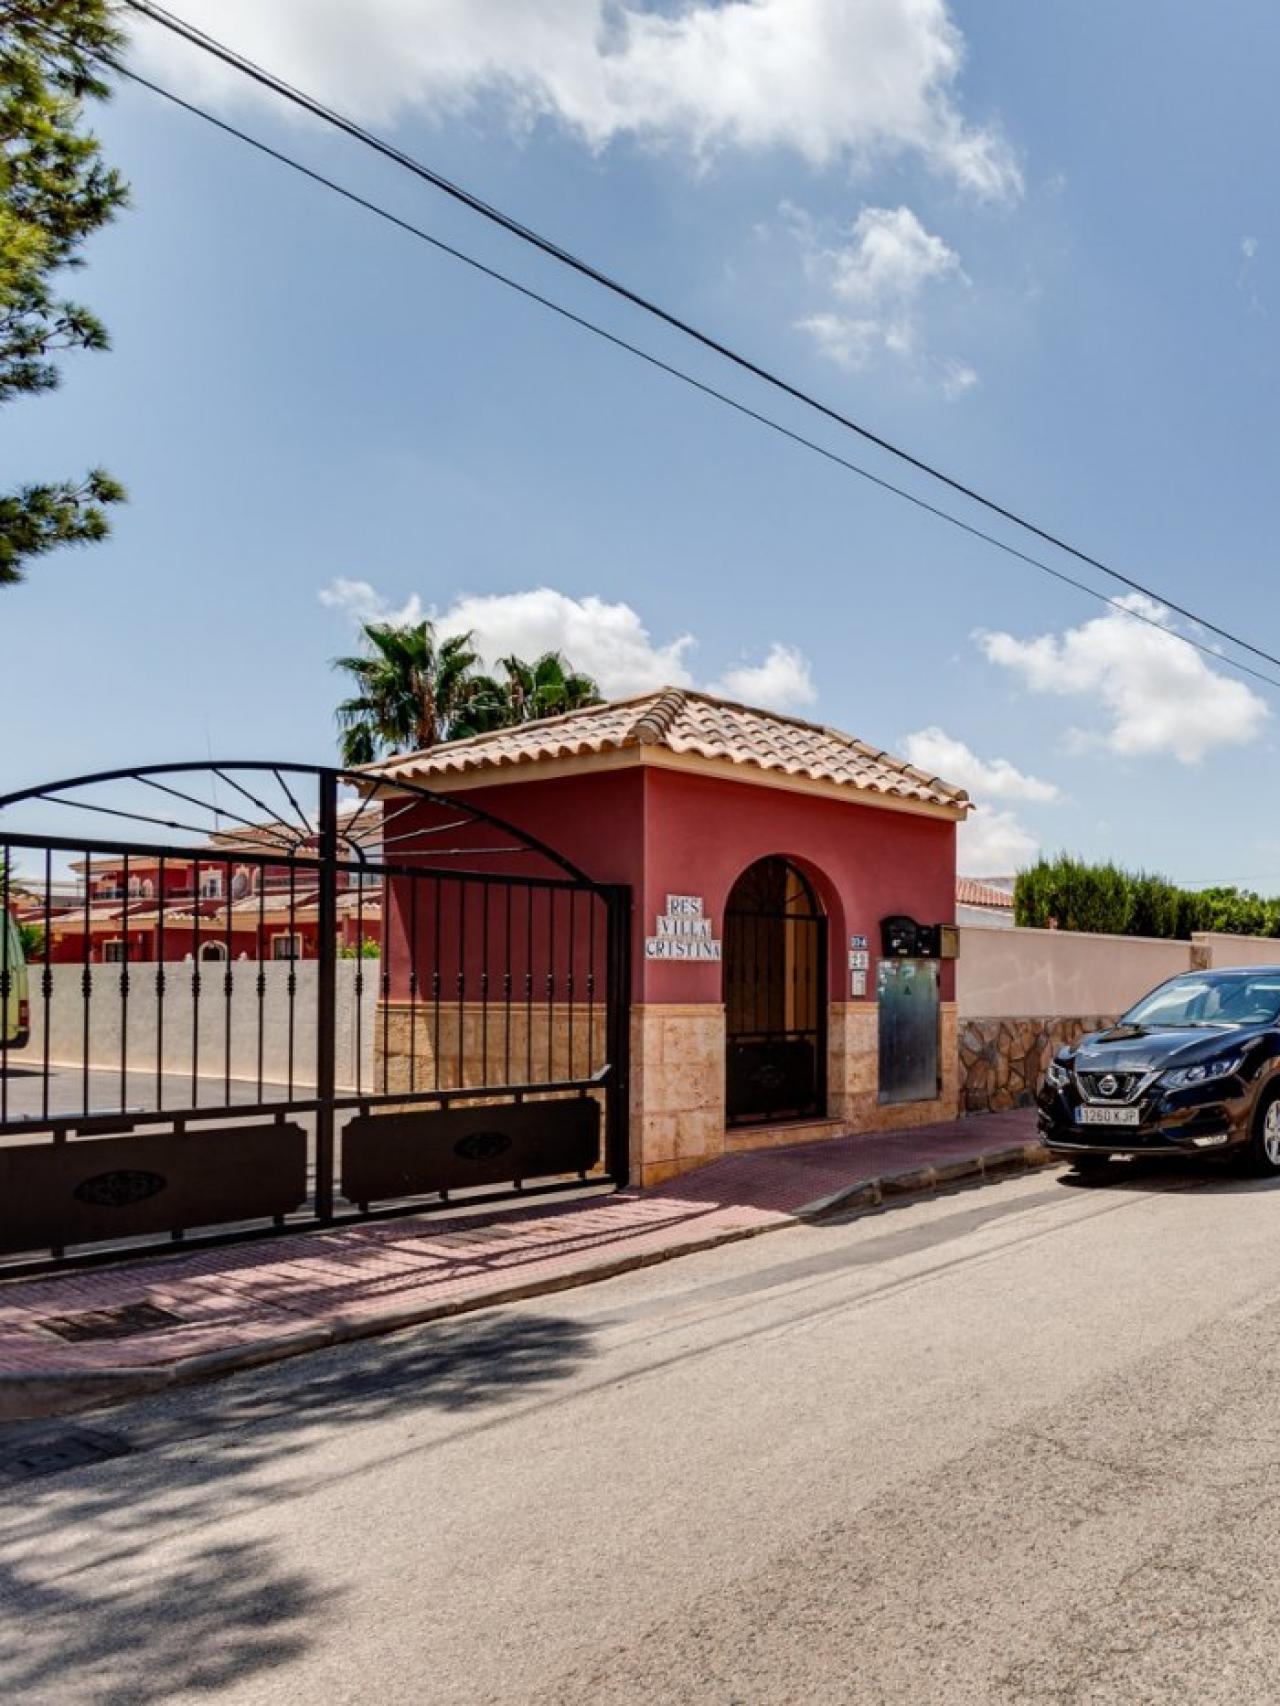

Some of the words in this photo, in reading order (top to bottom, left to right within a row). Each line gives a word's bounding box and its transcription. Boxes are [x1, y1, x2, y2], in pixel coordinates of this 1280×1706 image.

[671, 899, 699, 915] RES
[661, 919, 707, 936] VILLA
[647, 942, 719, 956] CRISTINA
